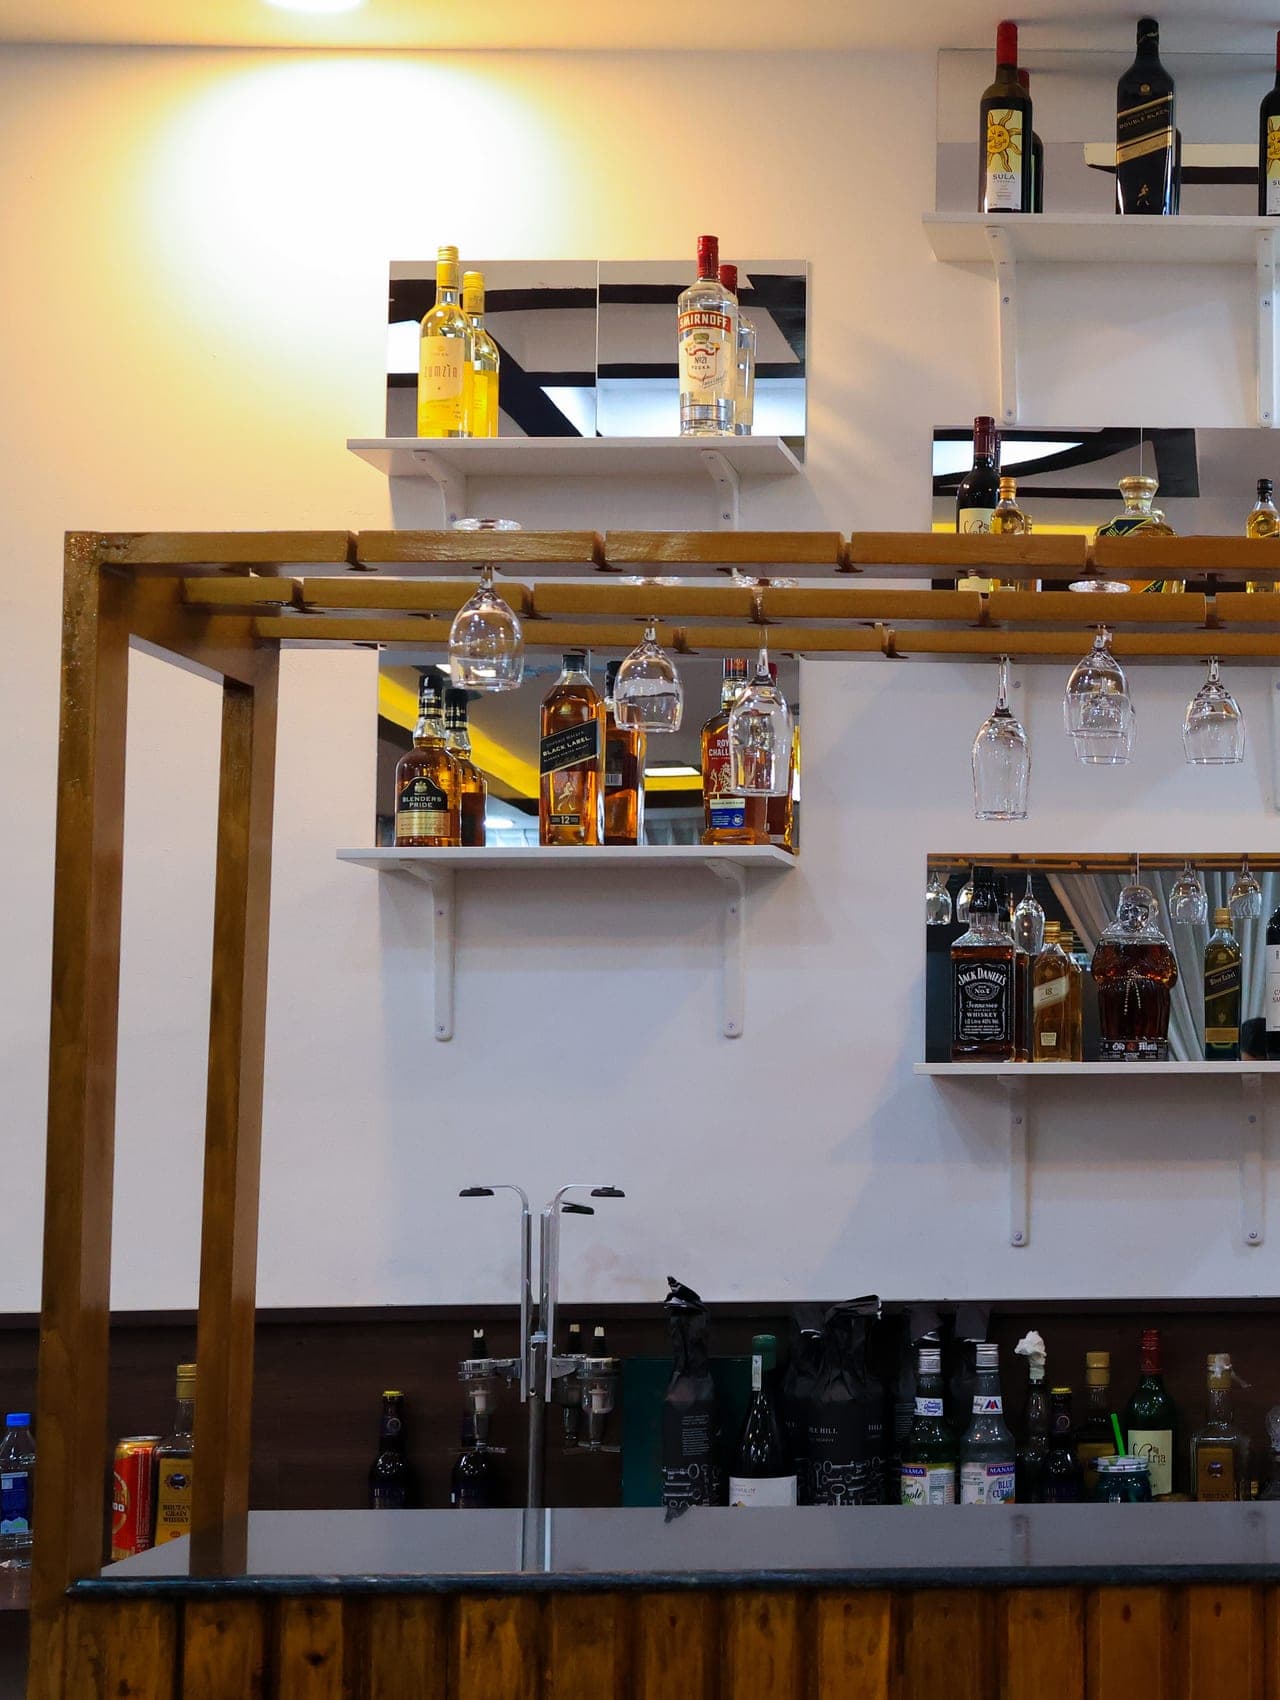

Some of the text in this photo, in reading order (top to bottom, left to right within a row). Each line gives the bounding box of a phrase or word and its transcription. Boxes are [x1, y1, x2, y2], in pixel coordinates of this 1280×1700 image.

[679, 311, 730, 329] SMIRNOFF
[542, 744, 567, 757] BLACK
[402, 794, 442, 803] BLENDERS
[409, 801, 433, 809] PRIDE
[560, 815, 571, 824] 12
[957, 967, 1008, 986] JACK DANIEL'S
[1044, 987, 1053, 997] 18
